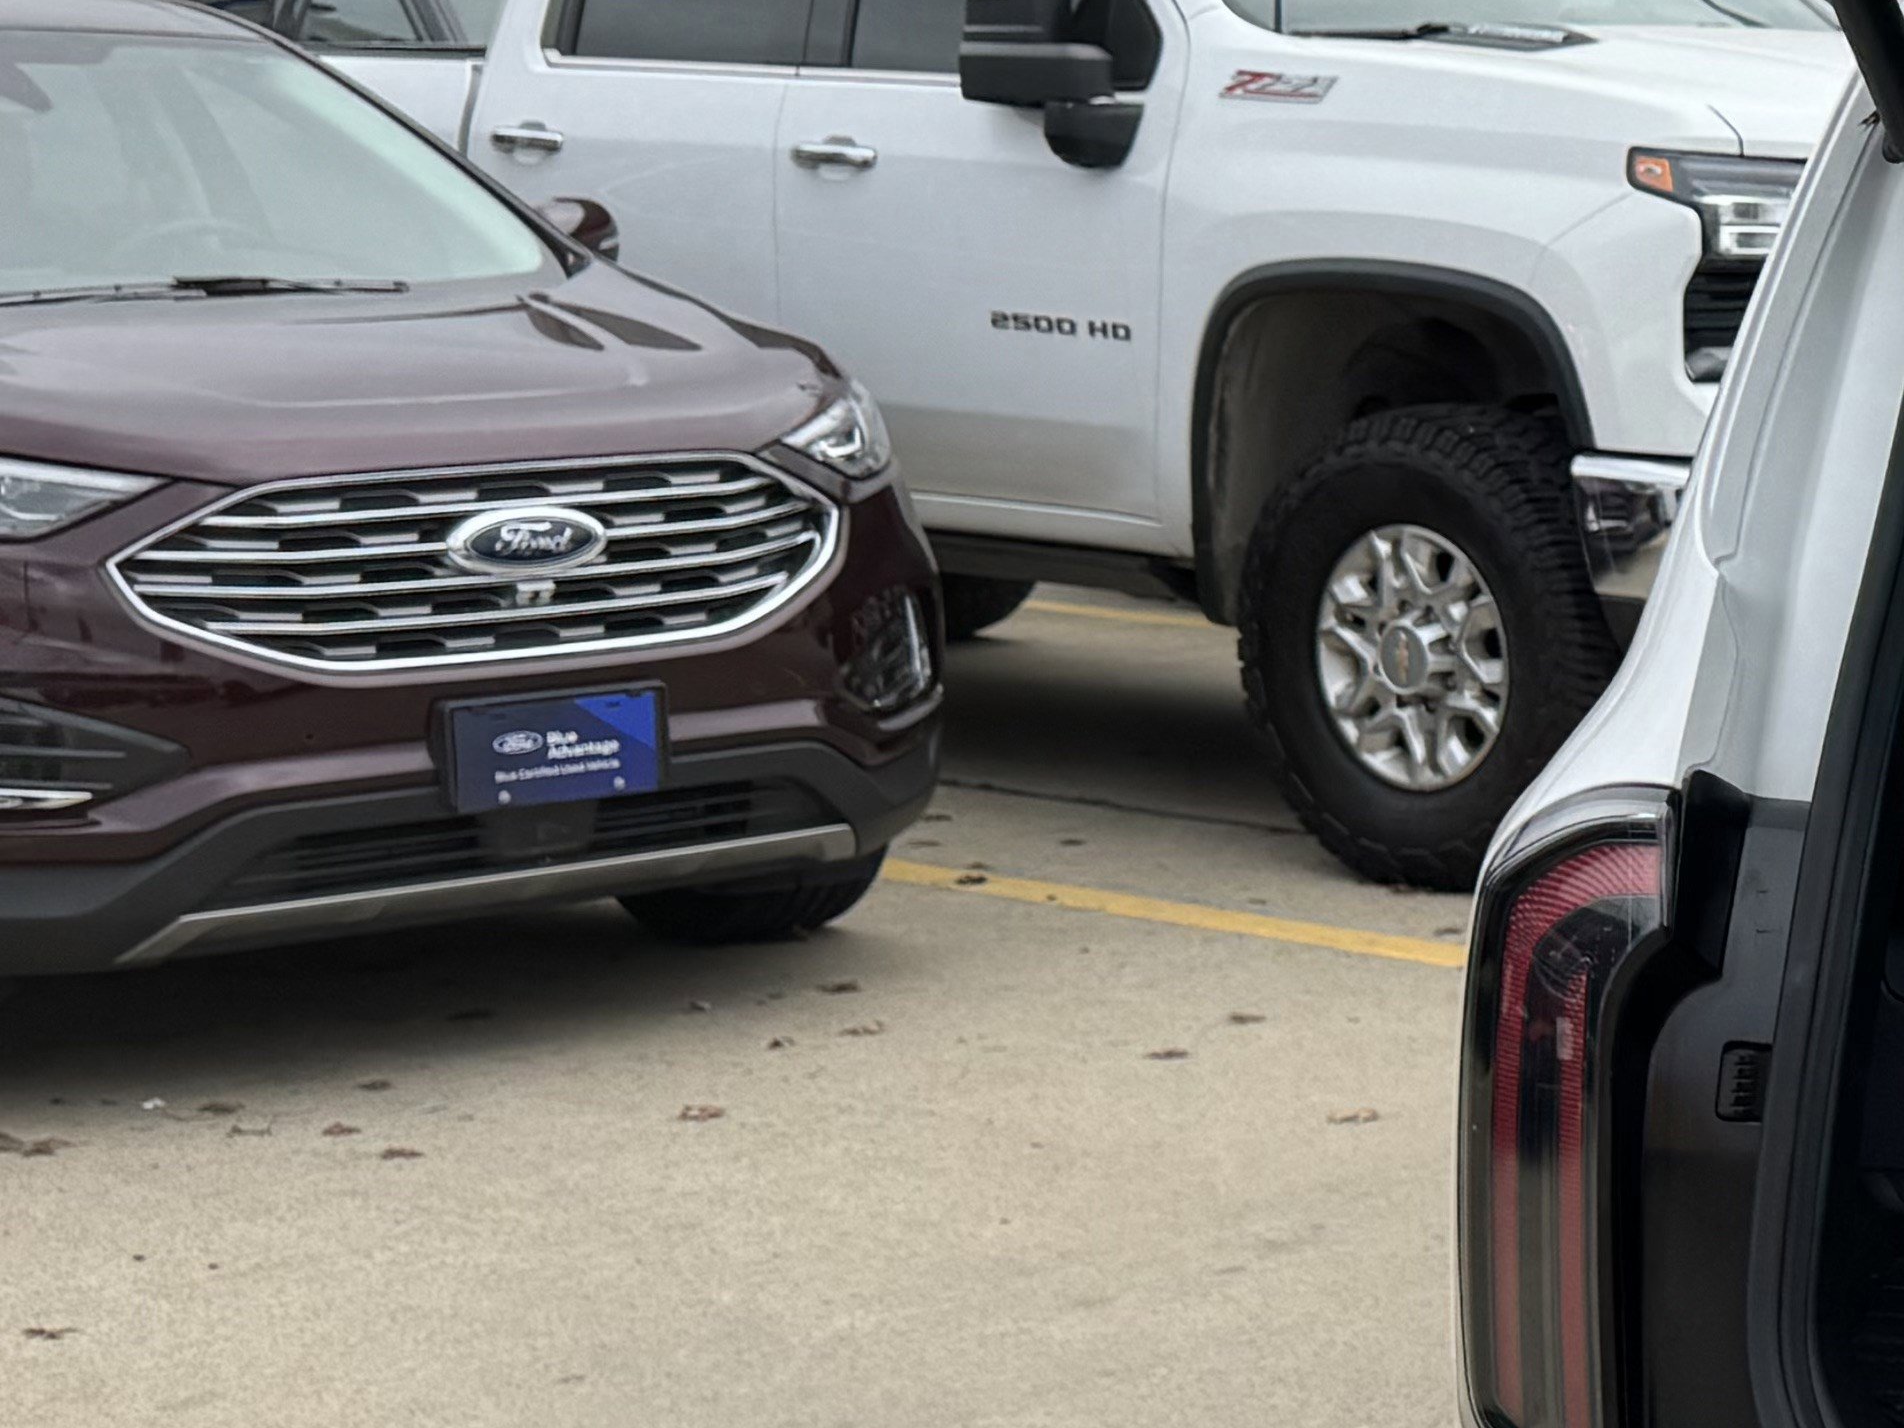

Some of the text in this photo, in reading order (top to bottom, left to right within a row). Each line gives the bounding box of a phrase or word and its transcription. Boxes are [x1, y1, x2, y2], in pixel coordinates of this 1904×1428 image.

[990, 310, 1132, 342] 2500 HD
[494, 521, 574, 555] Ford
[547, 739, 621, 759] Advantage
